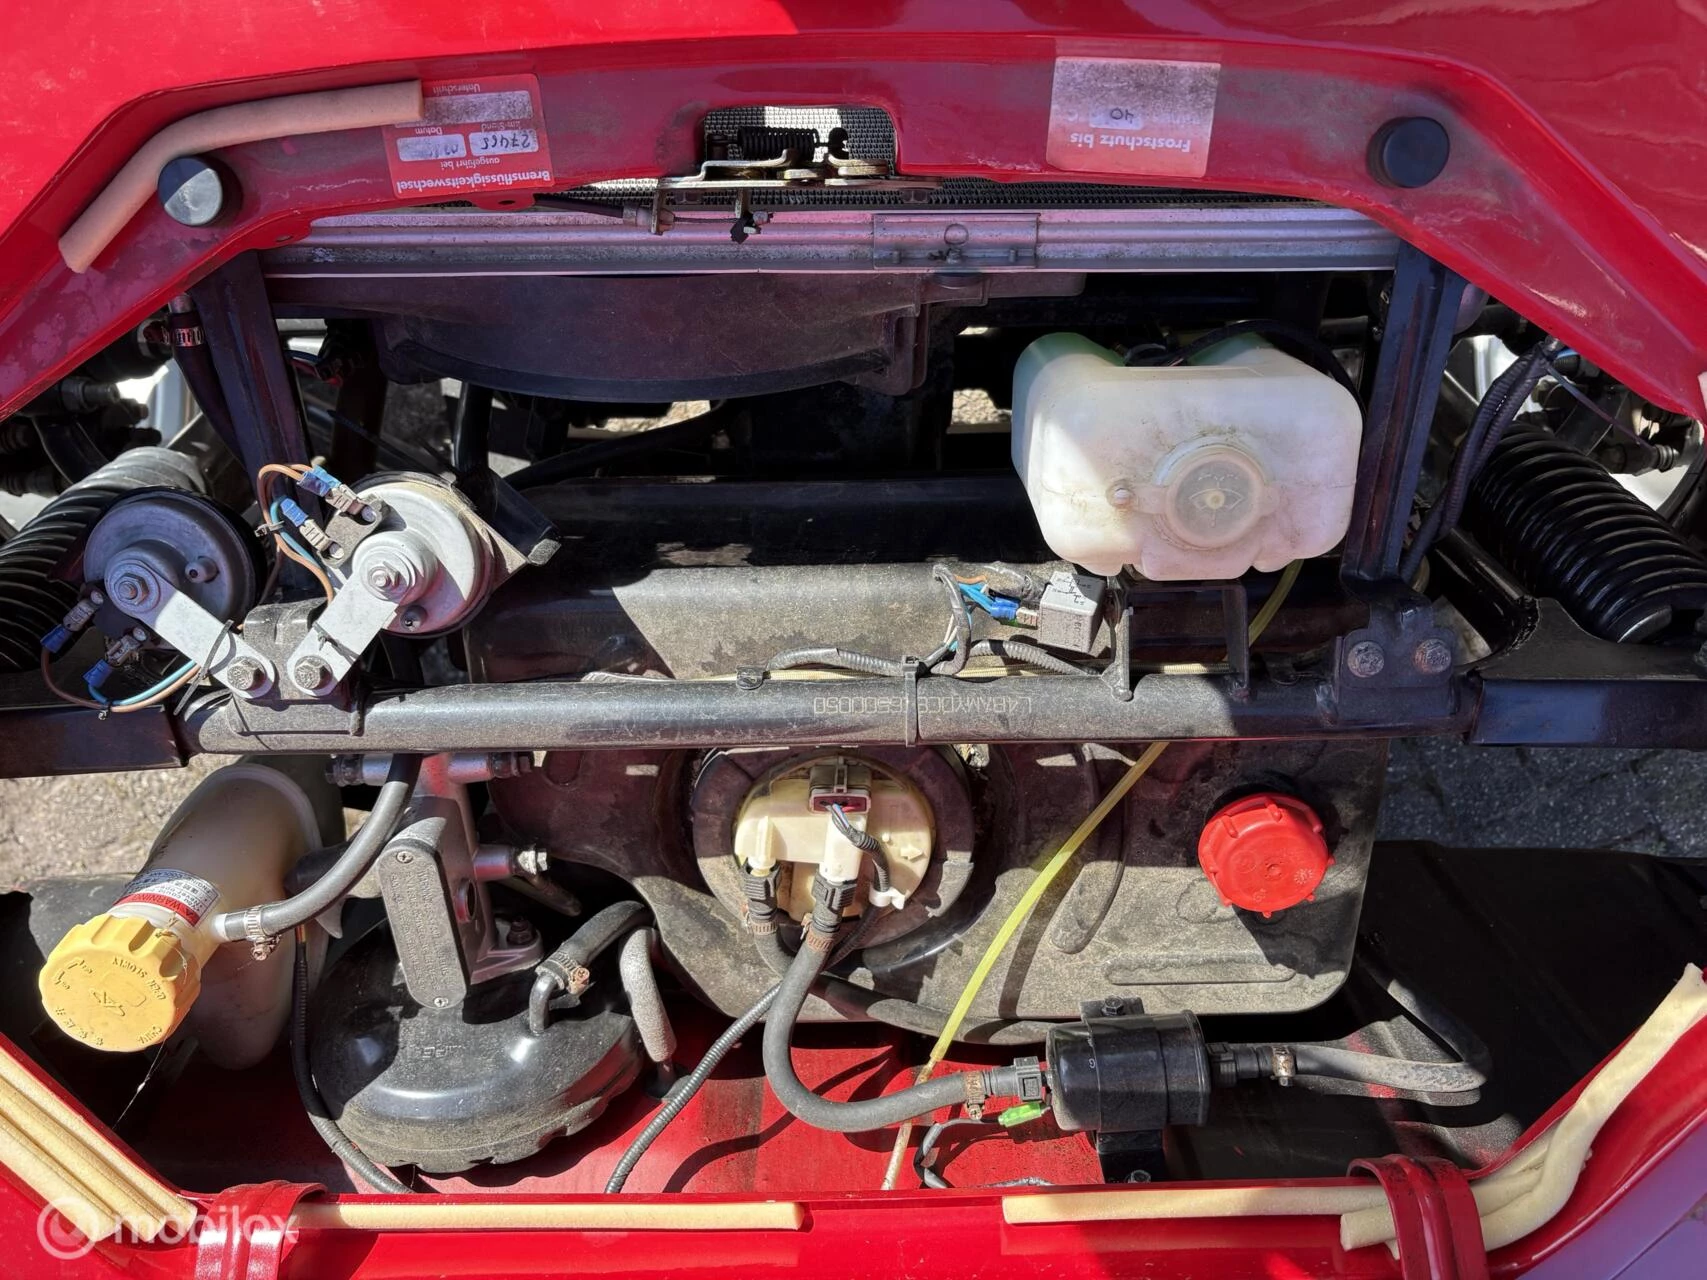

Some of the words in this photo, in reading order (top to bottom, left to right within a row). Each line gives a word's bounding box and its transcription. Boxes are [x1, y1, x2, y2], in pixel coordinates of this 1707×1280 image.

[1110, 107, 1135, 124] 40
[415, 126, 443, 135] Datum
[1069, 132, 1095, 147] bis
[1099, 134, 1192, 152] Frostschutz
[440, 161, 454, 170] bei
[456, 156, 500, 169] ausgeführt
[396, 170, 551, 194] Bremsflüssigkeitswechsel
[131, 892, 181, 910] WARNING
